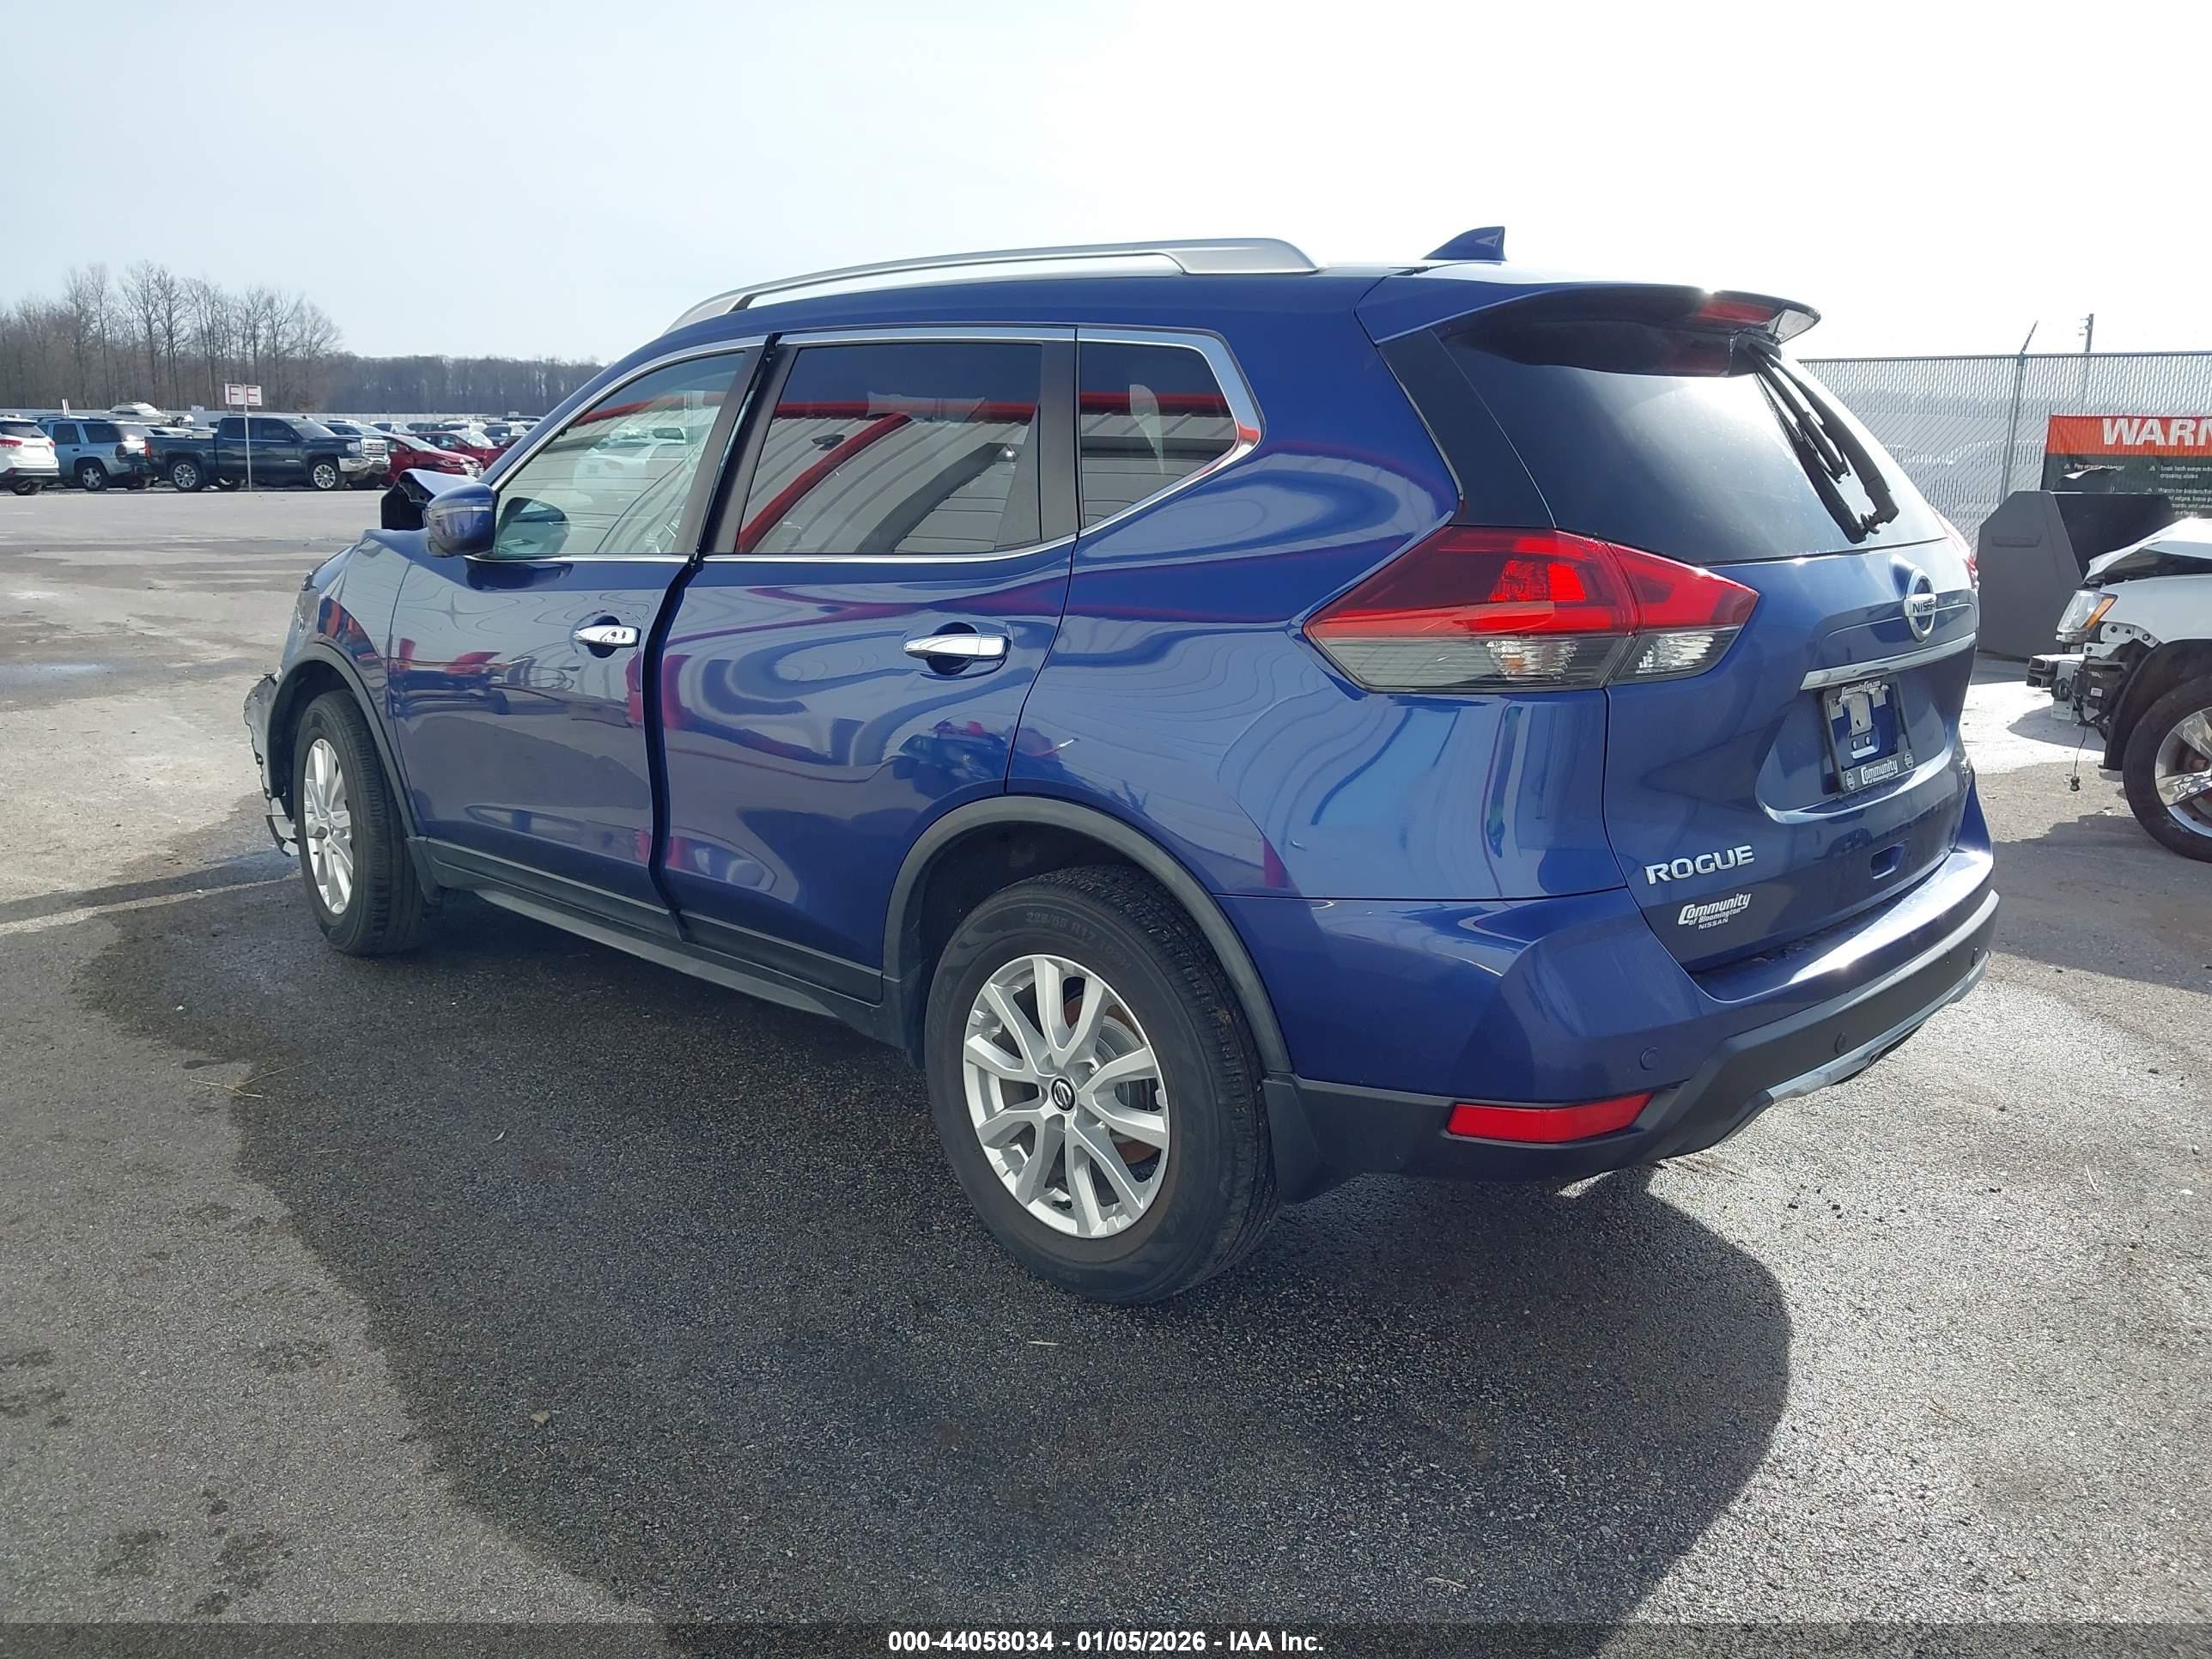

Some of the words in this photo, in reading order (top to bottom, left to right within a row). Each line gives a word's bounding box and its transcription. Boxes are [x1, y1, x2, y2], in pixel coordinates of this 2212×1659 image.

[1644, 845, 1755, 884] ROGUE
[1677, 893, 1752, 925] Community
[1698, 907, 1741, 923] Bloomington
[1698, 917, 1729, 931] NISSAN
